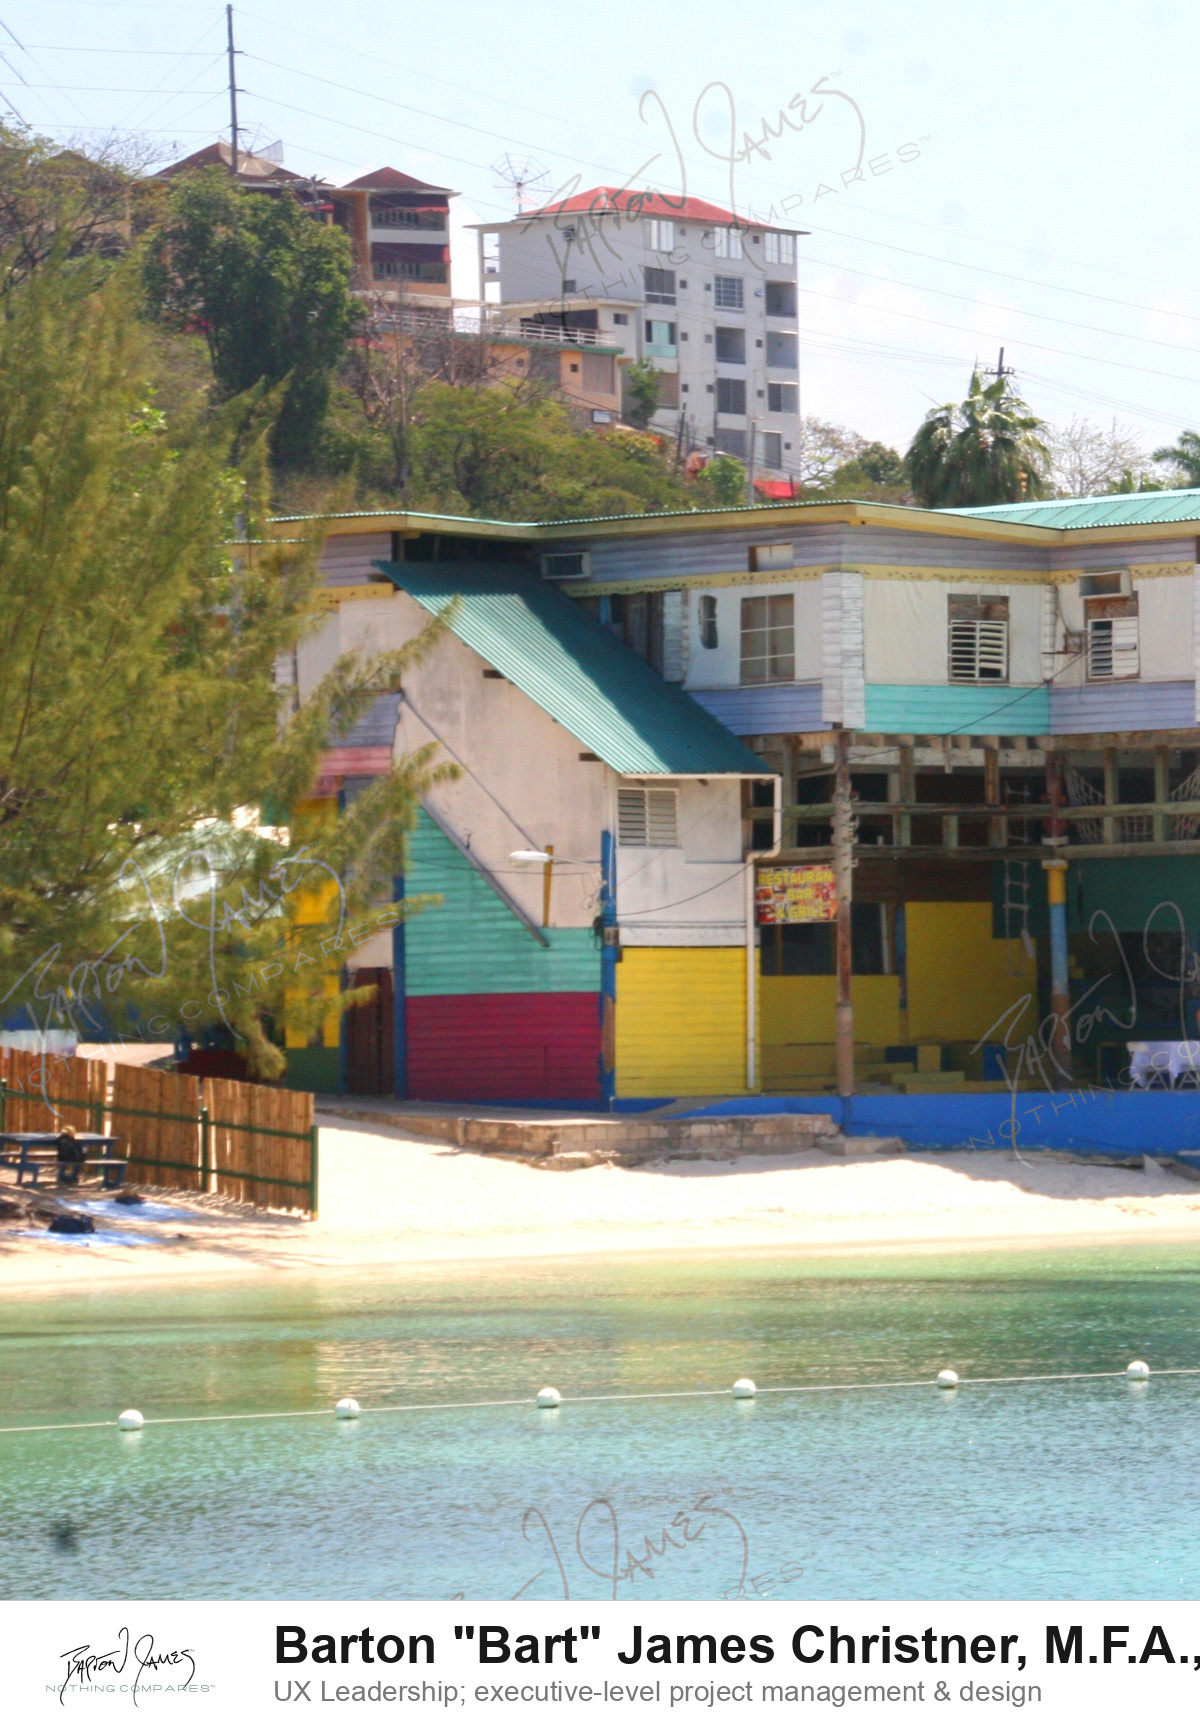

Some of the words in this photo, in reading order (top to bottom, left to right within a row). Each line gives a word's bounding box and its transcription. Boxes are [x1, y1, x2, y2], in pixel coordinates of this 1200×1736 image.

[758, 870, 834, 886] RESTAURAN
[786, 887, 813, 901] BAR
[776, 905, 785, 919] &
[789, 904, 827, 918] GRILL
